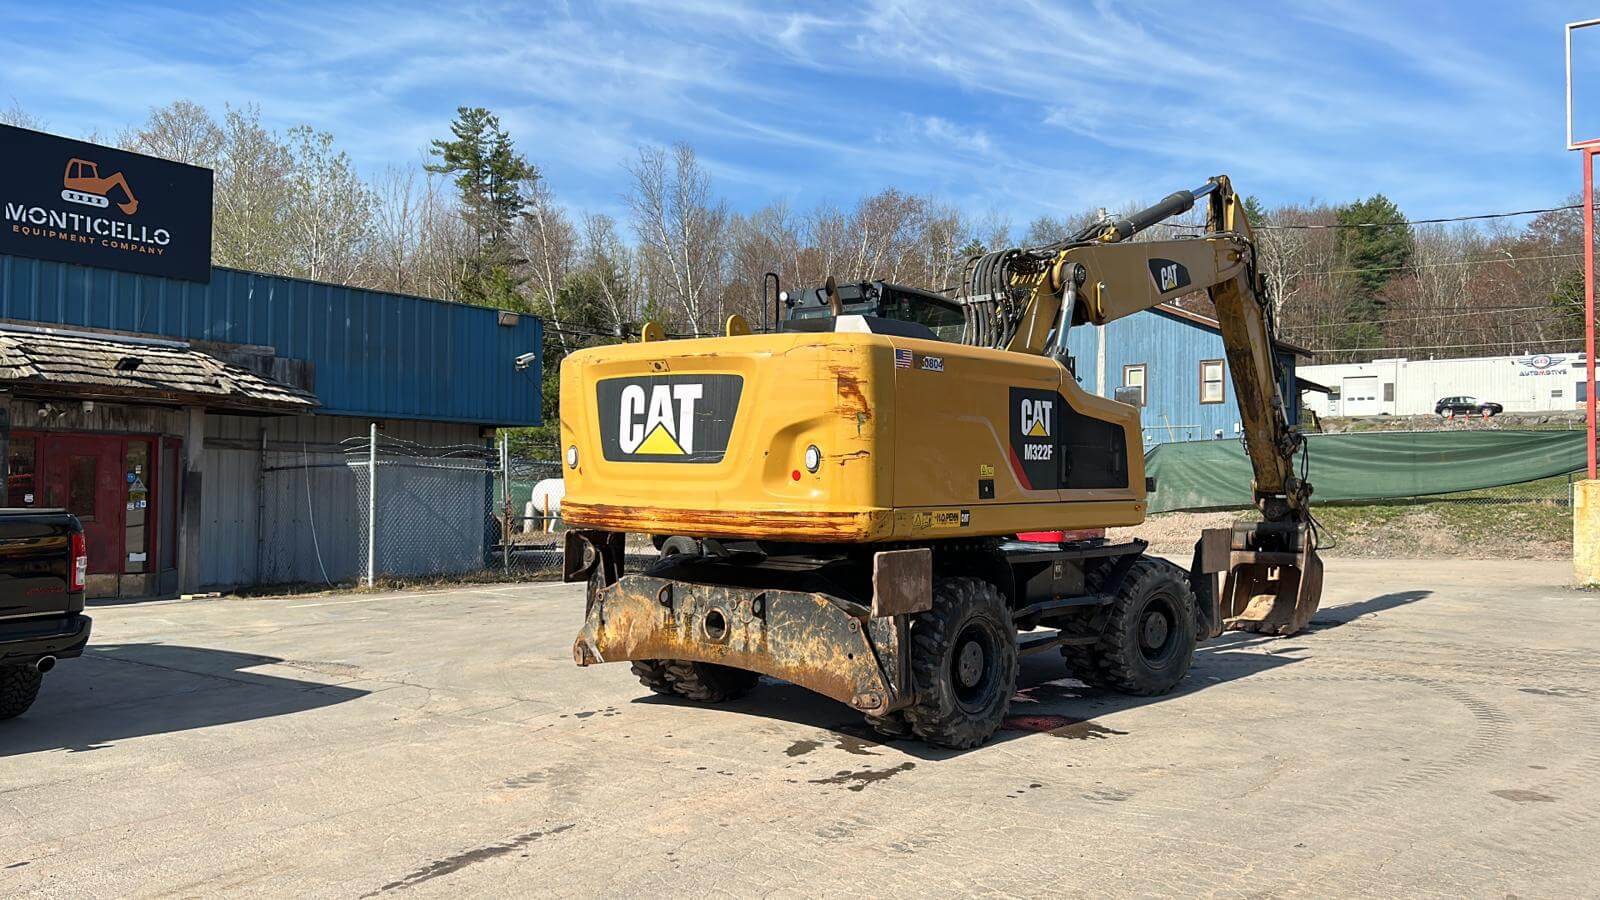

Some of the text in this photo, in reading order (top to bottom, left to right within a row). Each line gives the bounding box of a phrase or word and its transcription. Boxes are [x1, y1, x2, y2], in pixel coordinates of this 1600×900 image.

[5, 202, 171, 245] MONTICELLO
[12, 224, 164, 256] EQUIPMENT COMPANY
[1160, 263, 1178, 291] CAT
[619, 383, 703, 455] CAT
[1021, 398, 1053, 437] CAT
[1024, 443, 1053, 461] M322F
